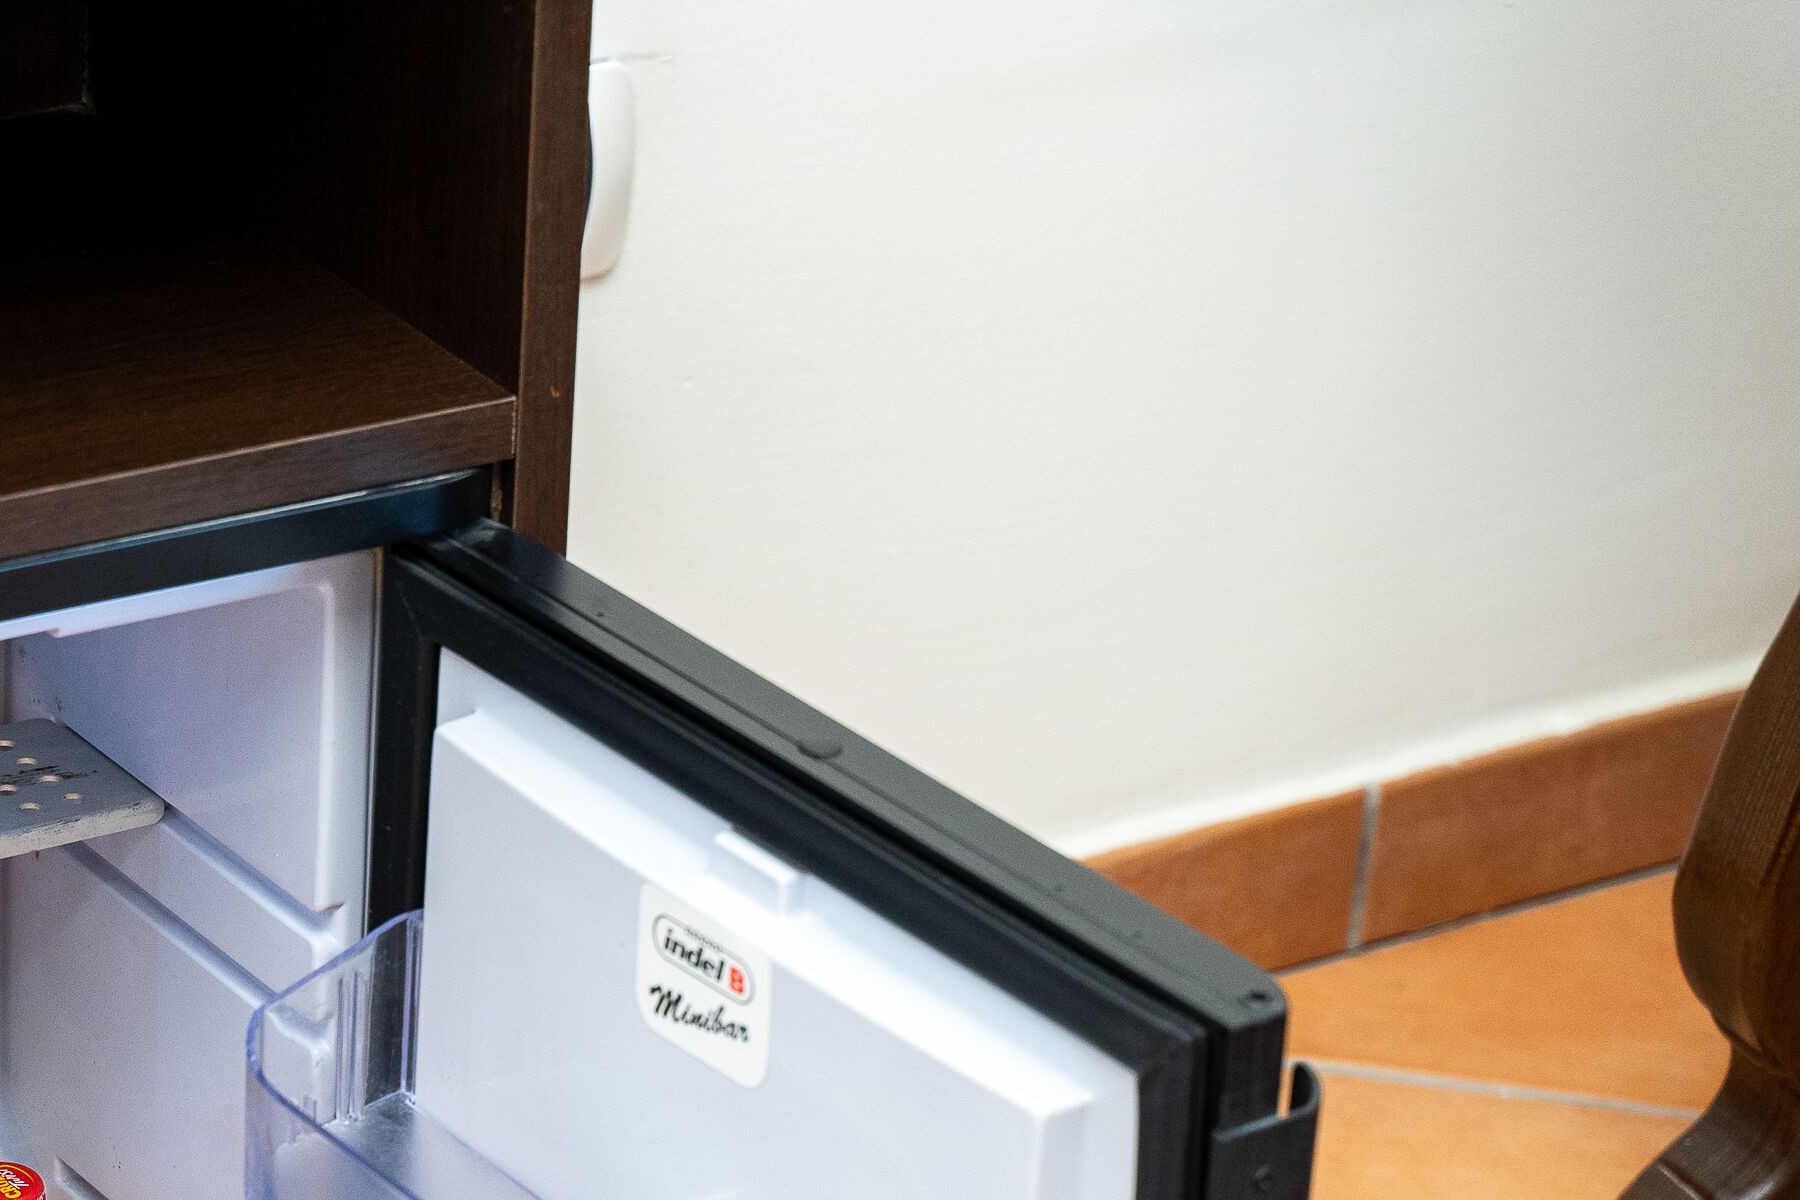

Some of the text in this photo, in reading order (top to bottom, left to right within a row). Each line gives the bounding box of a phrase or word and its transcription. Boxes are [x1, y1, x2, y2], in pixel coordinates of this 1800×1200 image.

[663, 928, 725, 982] indel
[729, 966, 746, 995] B
[649, 984, 751, 1042] Minibar
